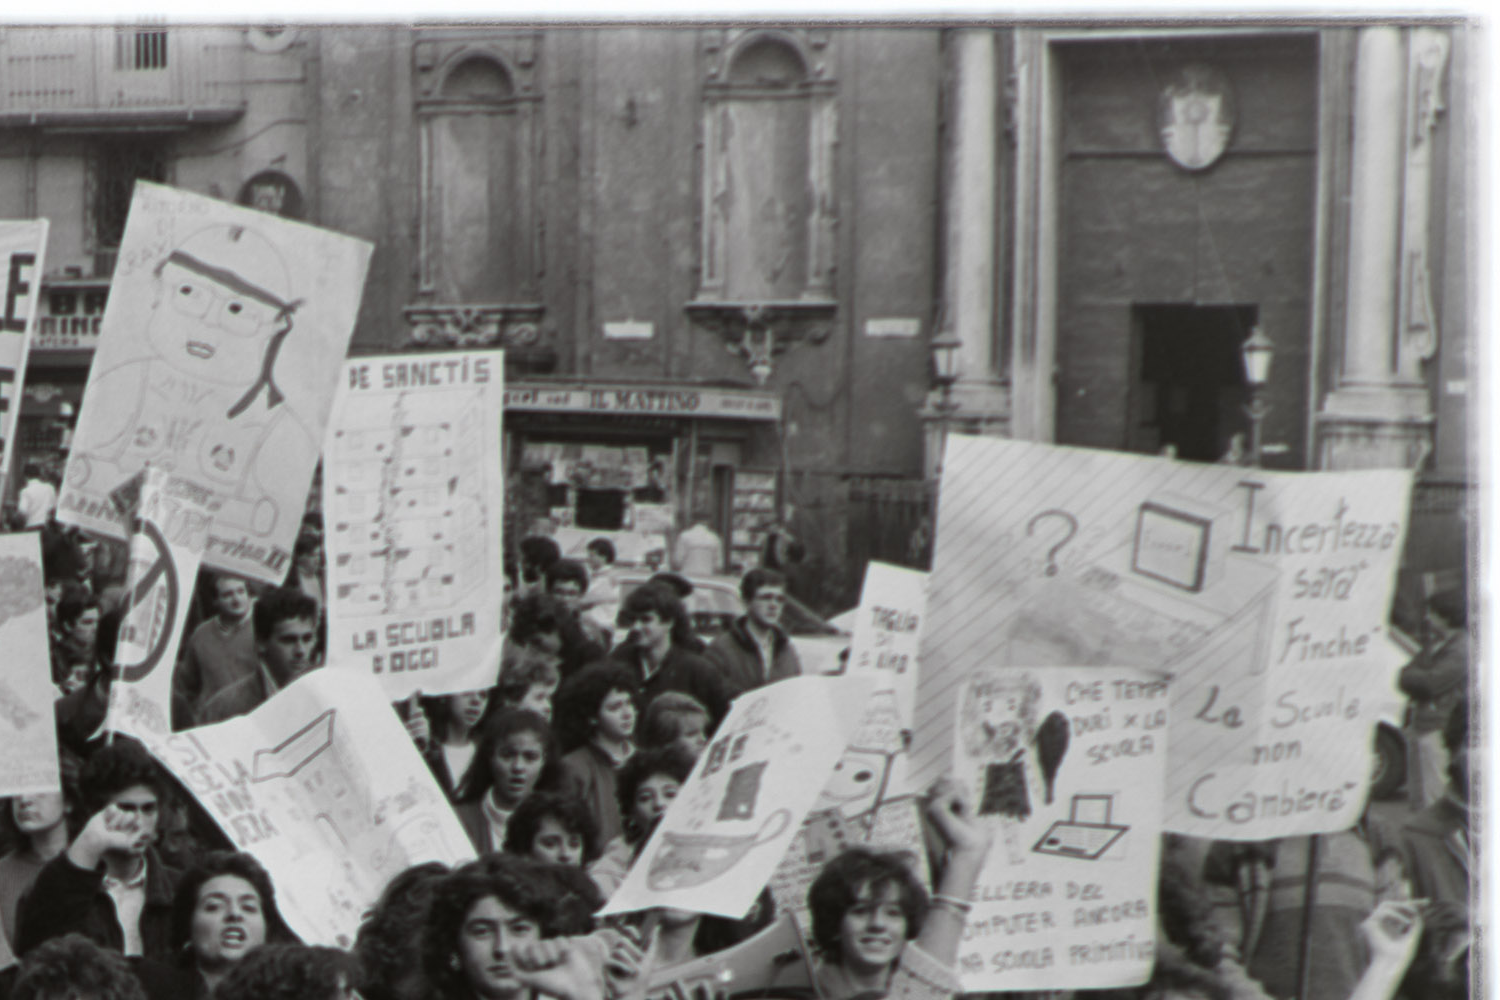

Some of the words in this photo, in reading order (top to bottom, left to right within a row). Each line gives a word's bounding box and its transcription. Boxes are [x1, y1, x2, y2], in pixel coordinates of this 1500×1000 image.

[383, 355, 491, 389] SANCTIS
[590, 389, 608, 410] IL
[614, 389, 700, 411] MATTINO
[1230, 481, 1400, 555] Incertezza
[353, 629, 377, 651] LA
[385, 611, 476, 648] SCUOLA
[1065, 680, 1105, 706] CHE
[1194, 684, 1245, 729] La
[1072, 705, 1112, 737] DURI
[1143, 709, 1167, 730] LA
[1085, 735, 1155, 766] SCUOLA
[1252, 739, 1303, 766] non
[971, 880, 1053, 903] ELL'ERA
[1065, 880, 1104, 901] DEL
[963, 911, 1055, 940] OMPUTER
[1072, 899, 1150, 928] ANCORA
[990, 946, 1055, 974] SCUOLA
